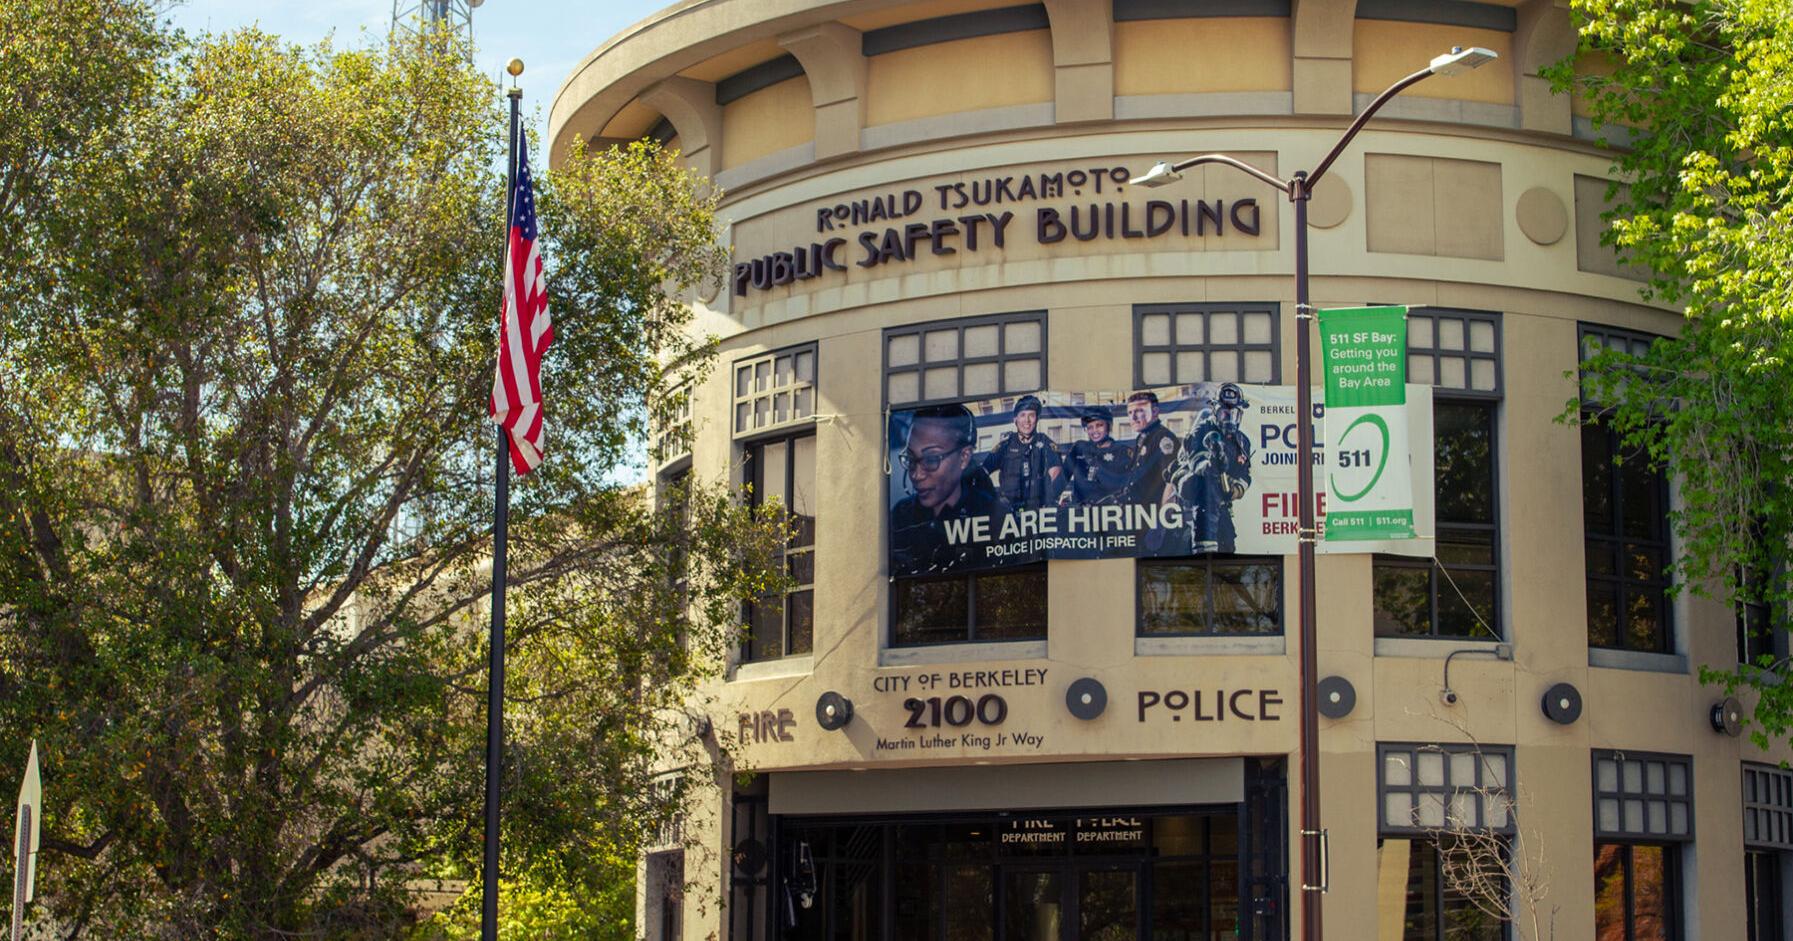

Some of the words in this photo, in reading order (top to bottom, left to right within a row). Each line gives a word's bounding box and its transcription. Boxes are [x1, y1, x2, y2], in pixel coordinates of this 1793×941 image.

[817, 189, 923, 233] RONALD
[935, 166, 1131, 210] TSUKAMOTO
[735, 237, 848, 297] PUBLIC
[856, 210, 1014, 269] SAFETY
[1037, 198, 1261, 244] BUILDING
[1330, 333, 1349, 344] 511
[1353, 332, 1369, 343] SF
[1371, 331, 1397, 344] Bay:
[1330, 347, 1373, 360] Getting
[1375, 348, 1398, 360] you
[1332, 361, 1375, 374] around
[1377, 361, 1397, 372] the
[1339, 377, 1361, 389] Bay
[1363, 376, 1391, 387] Area
[1260, 406, 1296, 414] BERKEL
[1261, 423, 1325, 449] POL
[1338, 449, 1371, 468] 511
[943, 515, 992, 545] WE
[999, 507, 1058, 540] ARE
[1068, 502, 1184, 533] HIRING
[1332, 517, 1349, 527] Call
[1350, 517, 1364, 526] 511
[1376, 515, 1407, 527] 511.org
[986, 541, 1028, 558] POLICE
[1035, 536, 1097, 551] DISPATCH
[1106, 535, 1136, 548] FIRE
[873, 675, 911, 693] CITY
[918, 673, 942, 690] OF
[949, 668, 1048, 689] BERKELEY
[903, 693, 1008, 729] 2100
[1138, 689, 1283, 722] POLICE
[738, 708, 797, 745] FIRE
[876, 736, 915, 750] Martin
[920, 733, 957, 749] Luther
[961, 733, 991, 750] King
[995, 733, 1007, 747] Jr
[1012, 732, 1044, 748] Way
[1002, 832, 1066, 843] DEPARTMENT
[1077, 830, 1143, 842] DEPARTMENT
